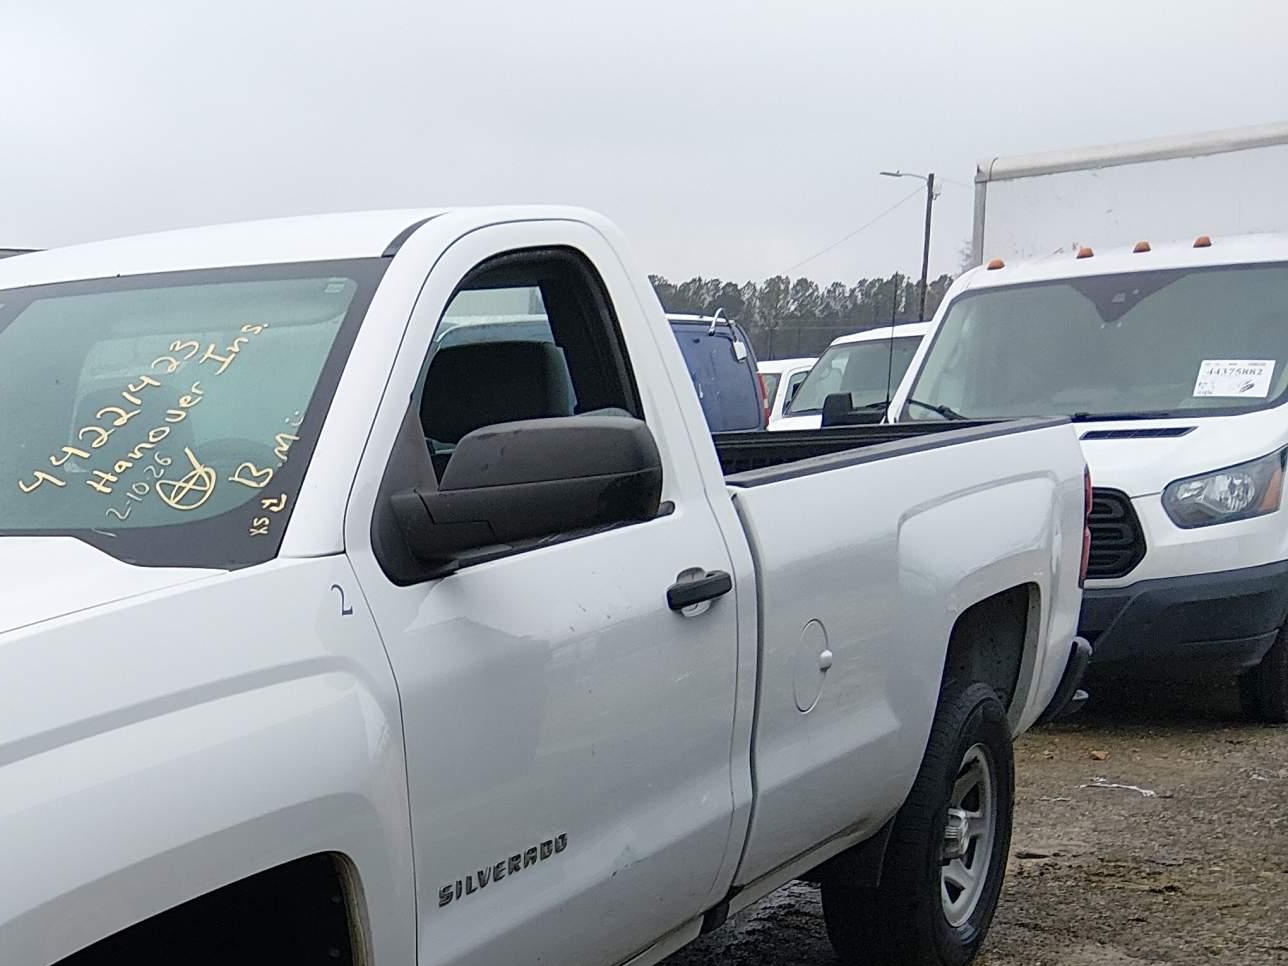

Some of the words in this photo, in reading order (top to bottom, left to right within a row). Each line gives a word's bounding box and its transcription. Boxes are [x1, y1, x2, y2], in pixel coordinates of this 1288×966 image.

[18, 339, 200, 493] 44221423
[86, 380, 204, 493] Hanover
[199, 322, 269, 376] Ins.
[438, 832, 568, 908] SILVERADO
